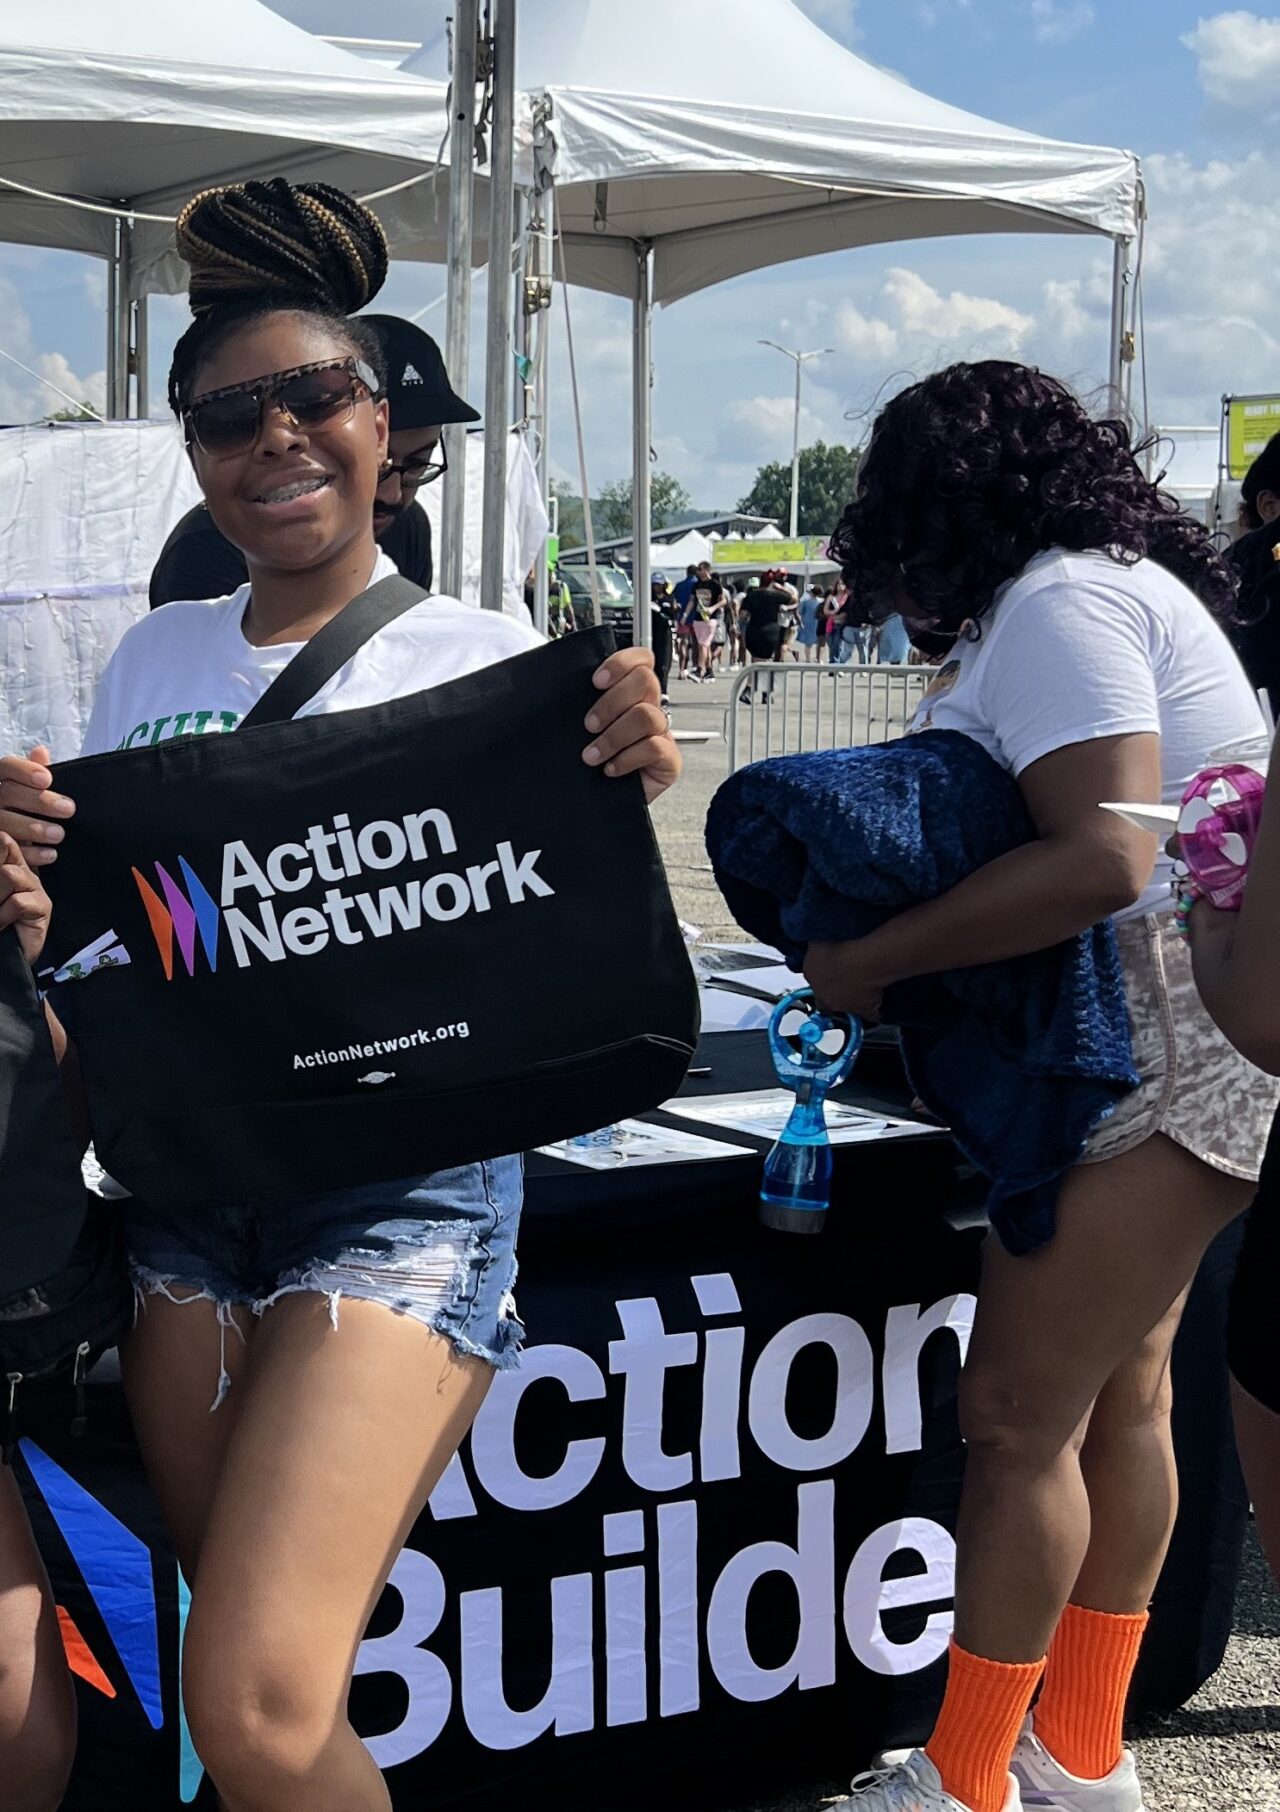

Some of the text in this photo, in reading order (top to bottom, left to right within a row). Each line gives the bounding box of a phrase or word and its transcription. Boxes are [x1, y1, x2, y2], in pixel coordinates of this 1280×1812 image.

[220, 807, 458, 908] Action
[222, 840, 556, 969] Network
[292, 1020, 471, 1070] ActionNetwork.org
[426, 1272, 977, 1521] ction
